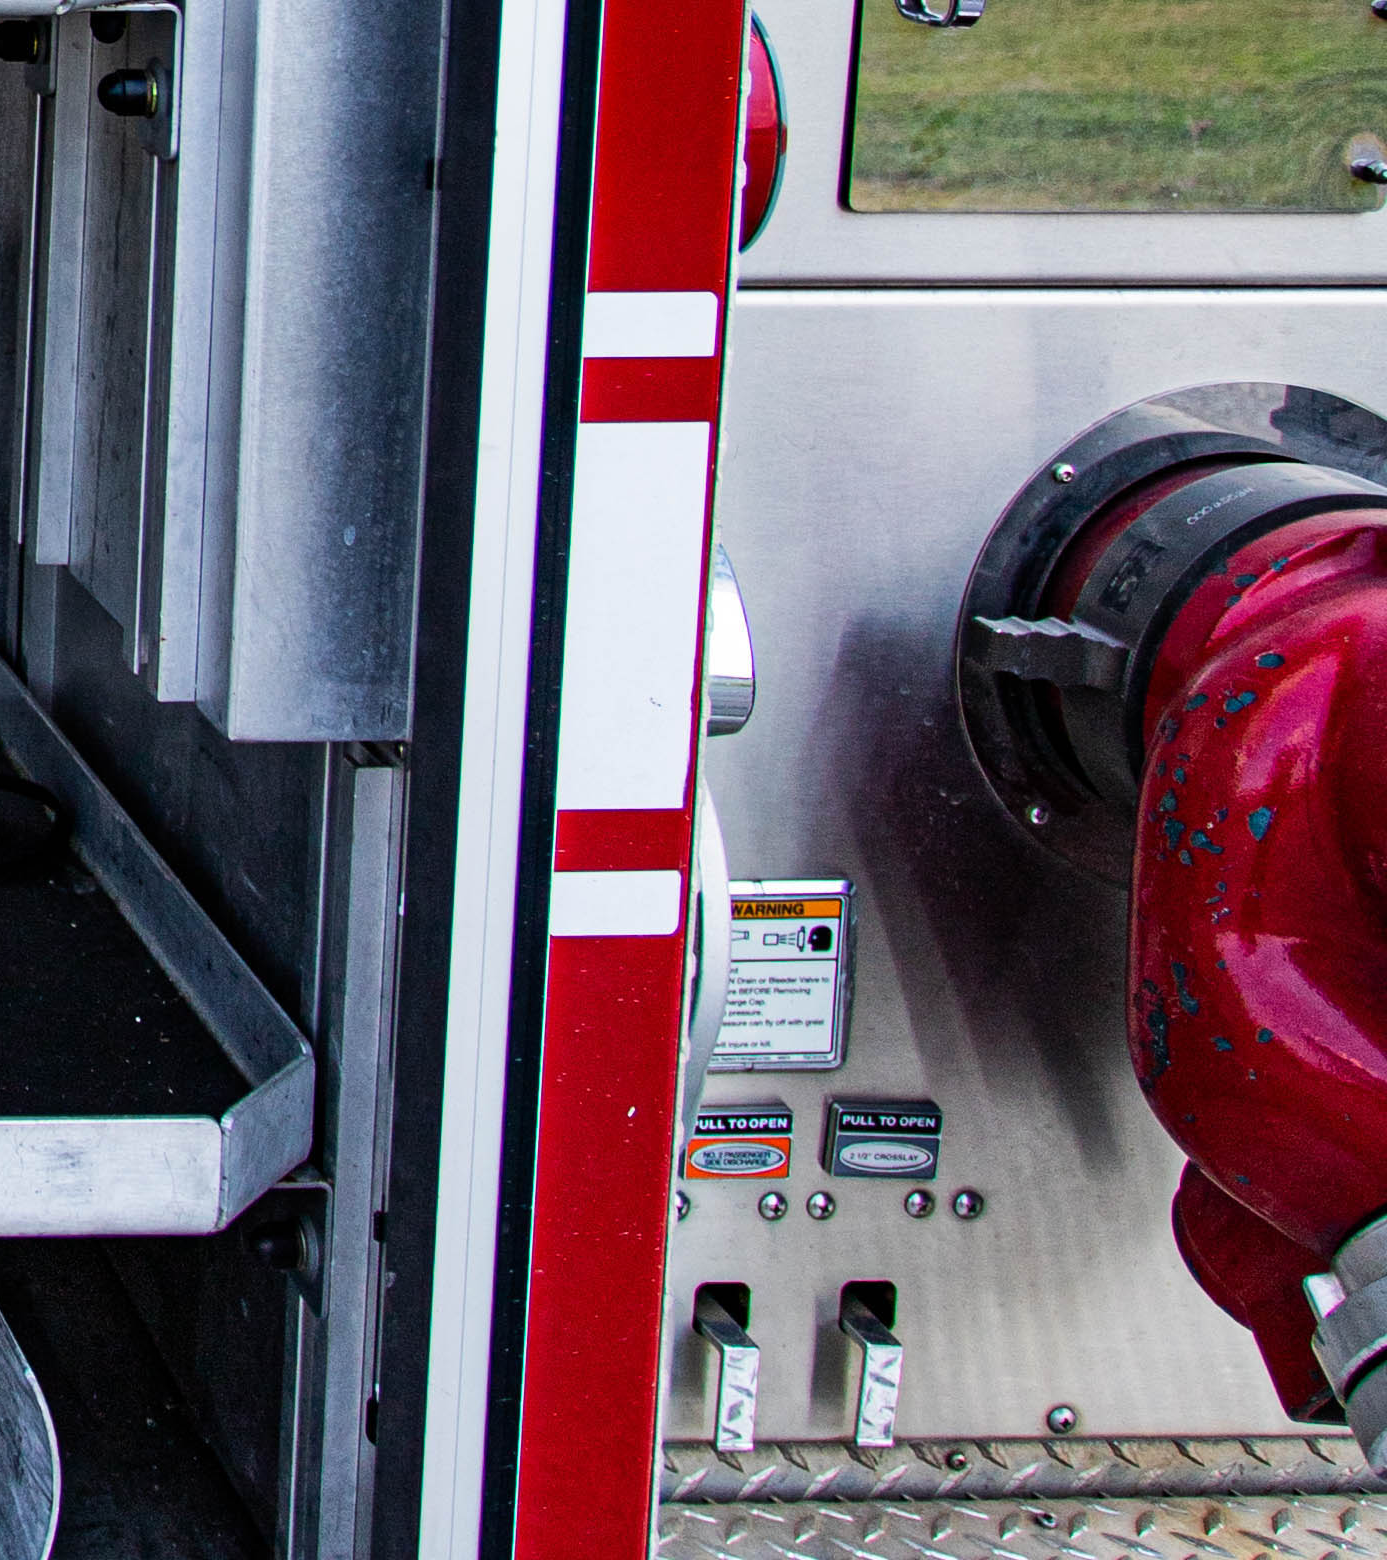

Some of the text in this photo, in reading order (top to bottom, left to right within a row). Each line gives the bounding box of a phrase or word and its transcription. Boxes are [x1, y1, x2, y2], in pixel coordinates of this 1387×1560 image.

[799, 976, 819, 984] Valve
[773, 987, 811, 996] Removing
[765, 1019, 773, 1028] fly
[696, 1118, 788, 1130] ULL TO OPEN
[842, 1115, 936, 1128] PULL TO OPEN
[873, 1153, 918, 1161] CROSSLAY
